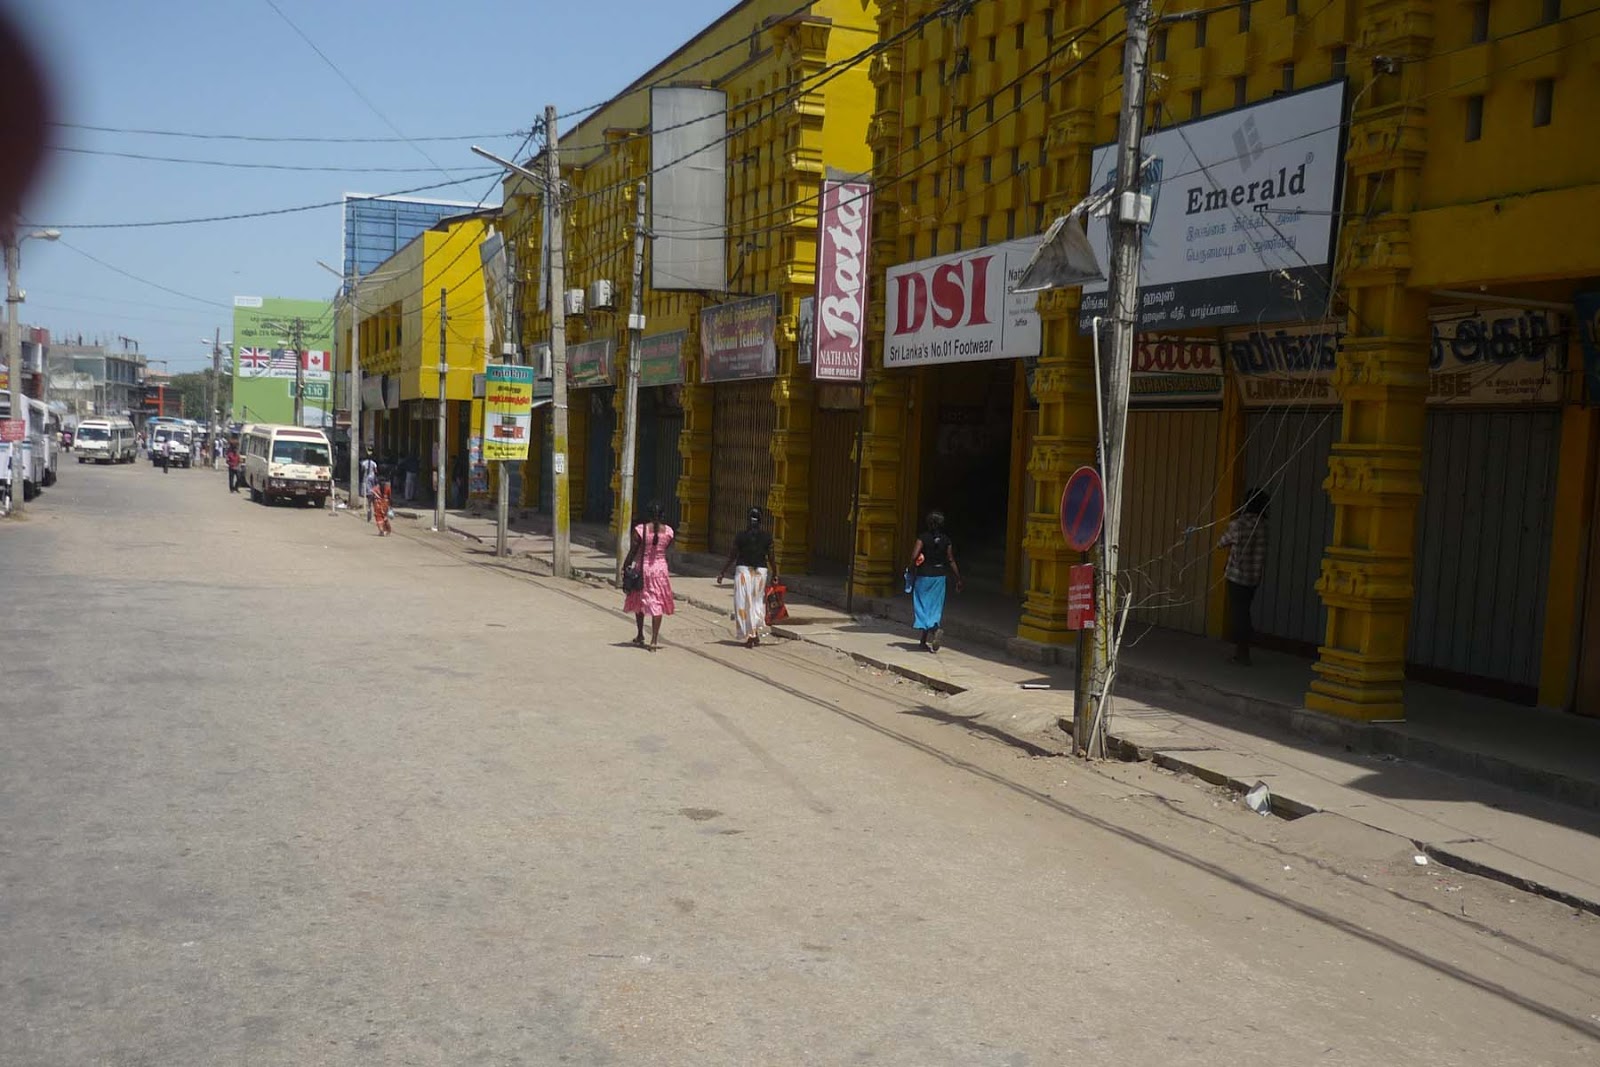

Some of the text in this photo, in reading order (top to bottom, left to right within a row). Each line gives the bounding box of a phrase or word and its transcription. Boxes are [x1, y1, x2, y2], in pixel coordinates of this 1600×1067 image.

[1185, 163, 1306, 215] Emerald
[821, 187, 865, 348] Bata
[893, 255, 996, 336] DSI
[890, 339, 993, 361] Sri Lanka's No.01 Footwear
[1132, 331, 1217, 371] Bata
